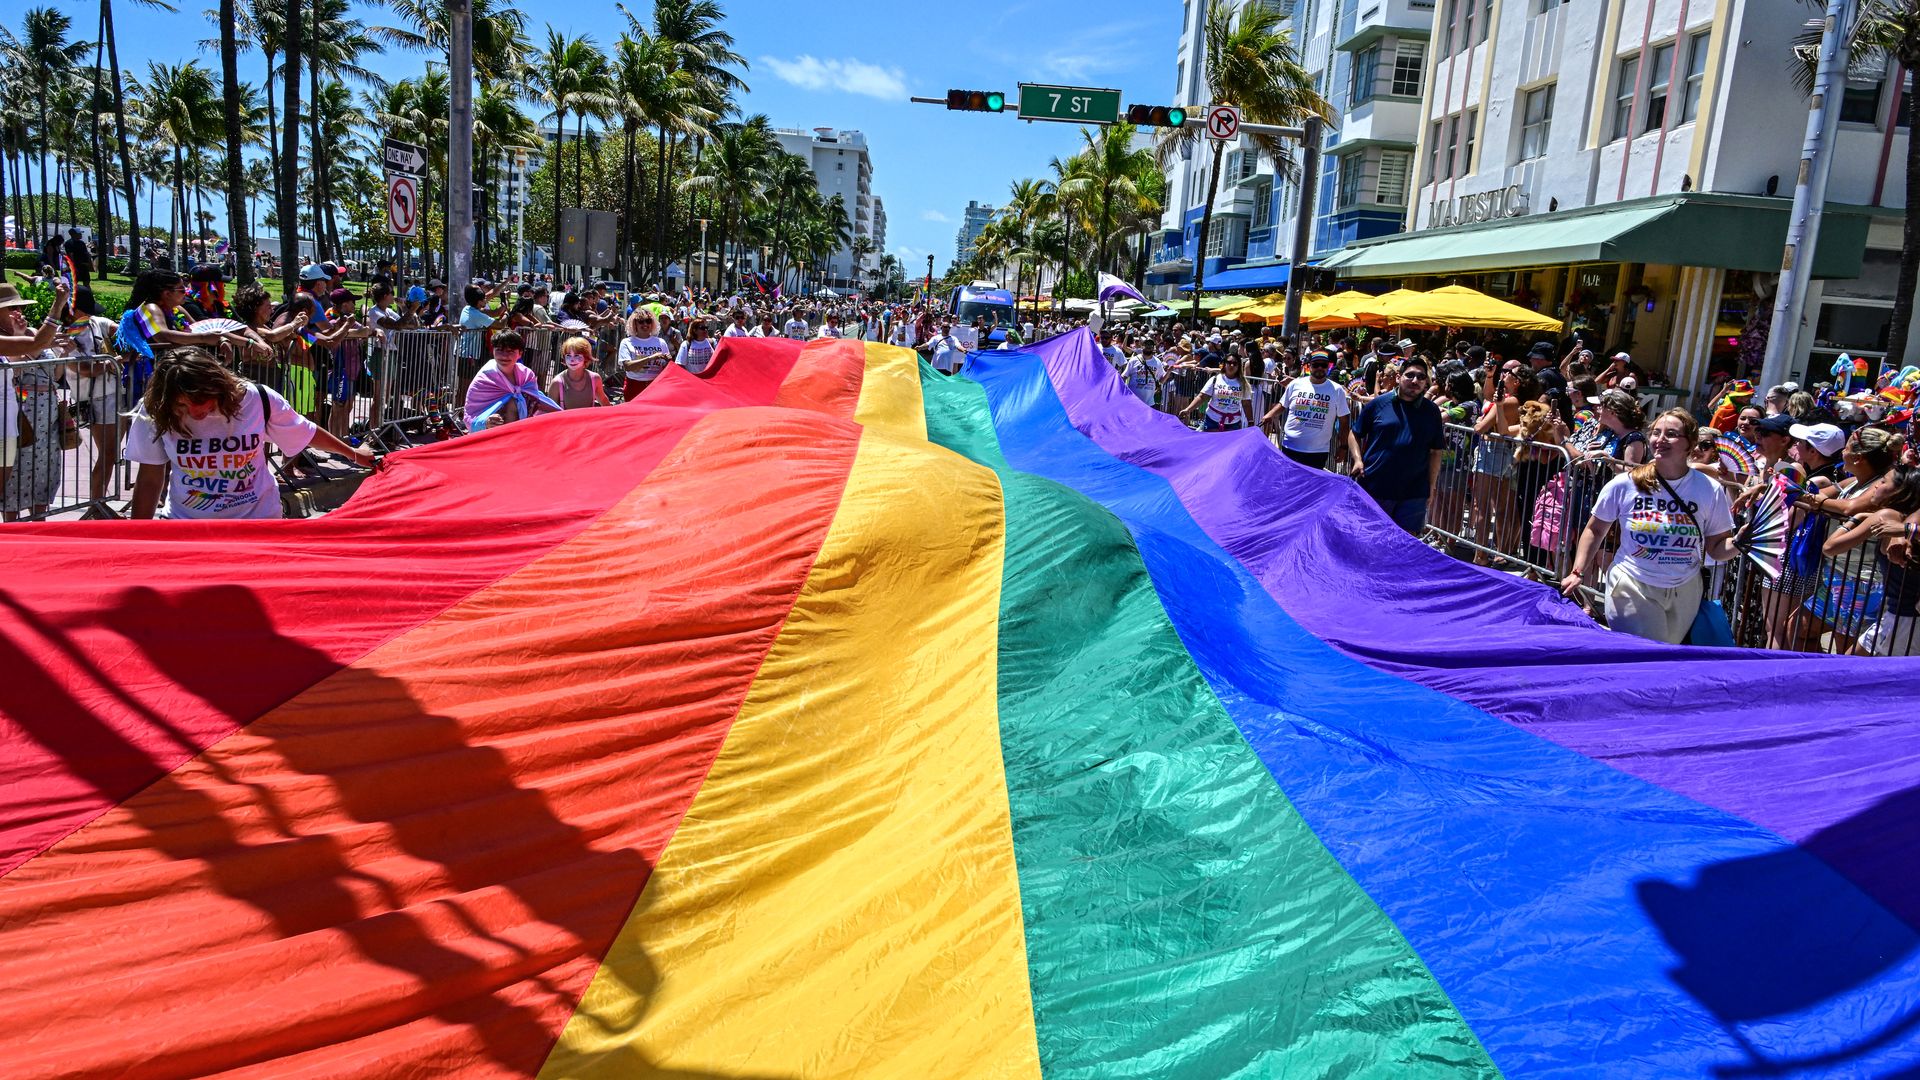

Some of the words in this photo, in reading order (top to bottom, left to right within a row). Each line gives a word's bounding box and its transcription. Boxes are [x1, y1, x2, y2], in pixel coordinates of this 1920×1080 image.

[1048, 93, 1062, 113] 7
[1070, 96, 1092, 113] ST
[388, 148, 399, 162] ONE
[400, 152, 413, 165] WAY
[1427, 184, 1526, 229] MAJESTIC
[1308, 392, 1330, 400] BOLD
[1294, 410, 1311, 418] LOVE
[177, 439, 202, 454] BE
[209, 433, 260, 454] BOLD
[177, 456, 217, 469] LIVE
[1634, 497, 1653, 510] BE
[1632, 512, 1663, 523] LIVE
[1667, 514, 1697, 525] FRE
[1631, 521, 1660, 532] STAY
[1630, 531, 1669, 546] LOVE
[1672, 538, 1697, 548] ALL
